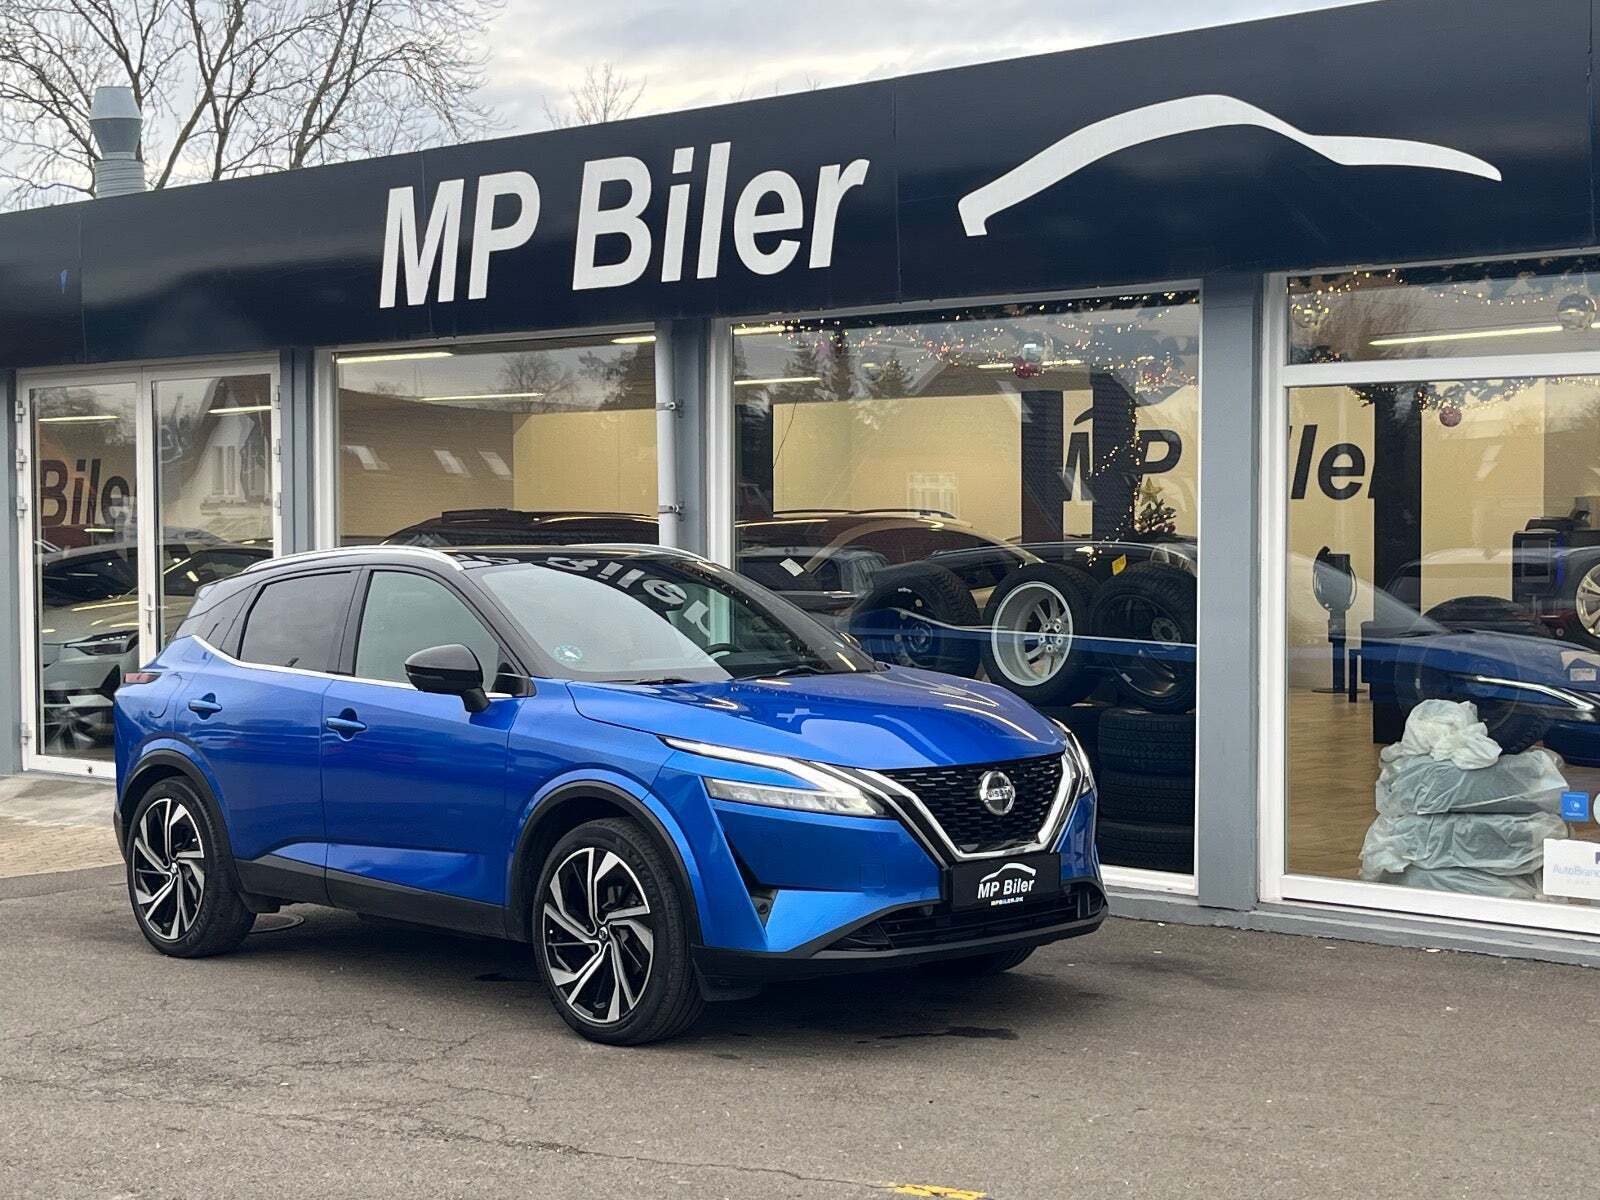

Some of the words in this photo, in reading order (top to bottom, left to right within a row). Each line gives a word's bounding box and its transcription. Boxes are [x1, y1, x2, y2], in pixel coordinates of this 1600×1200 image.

[379, 170, 541, 309] MP
[572, 141, 870, 291] Biler
[977, 881, 1000, 899] MP
[1003, 877, 1035, 895] Biler
